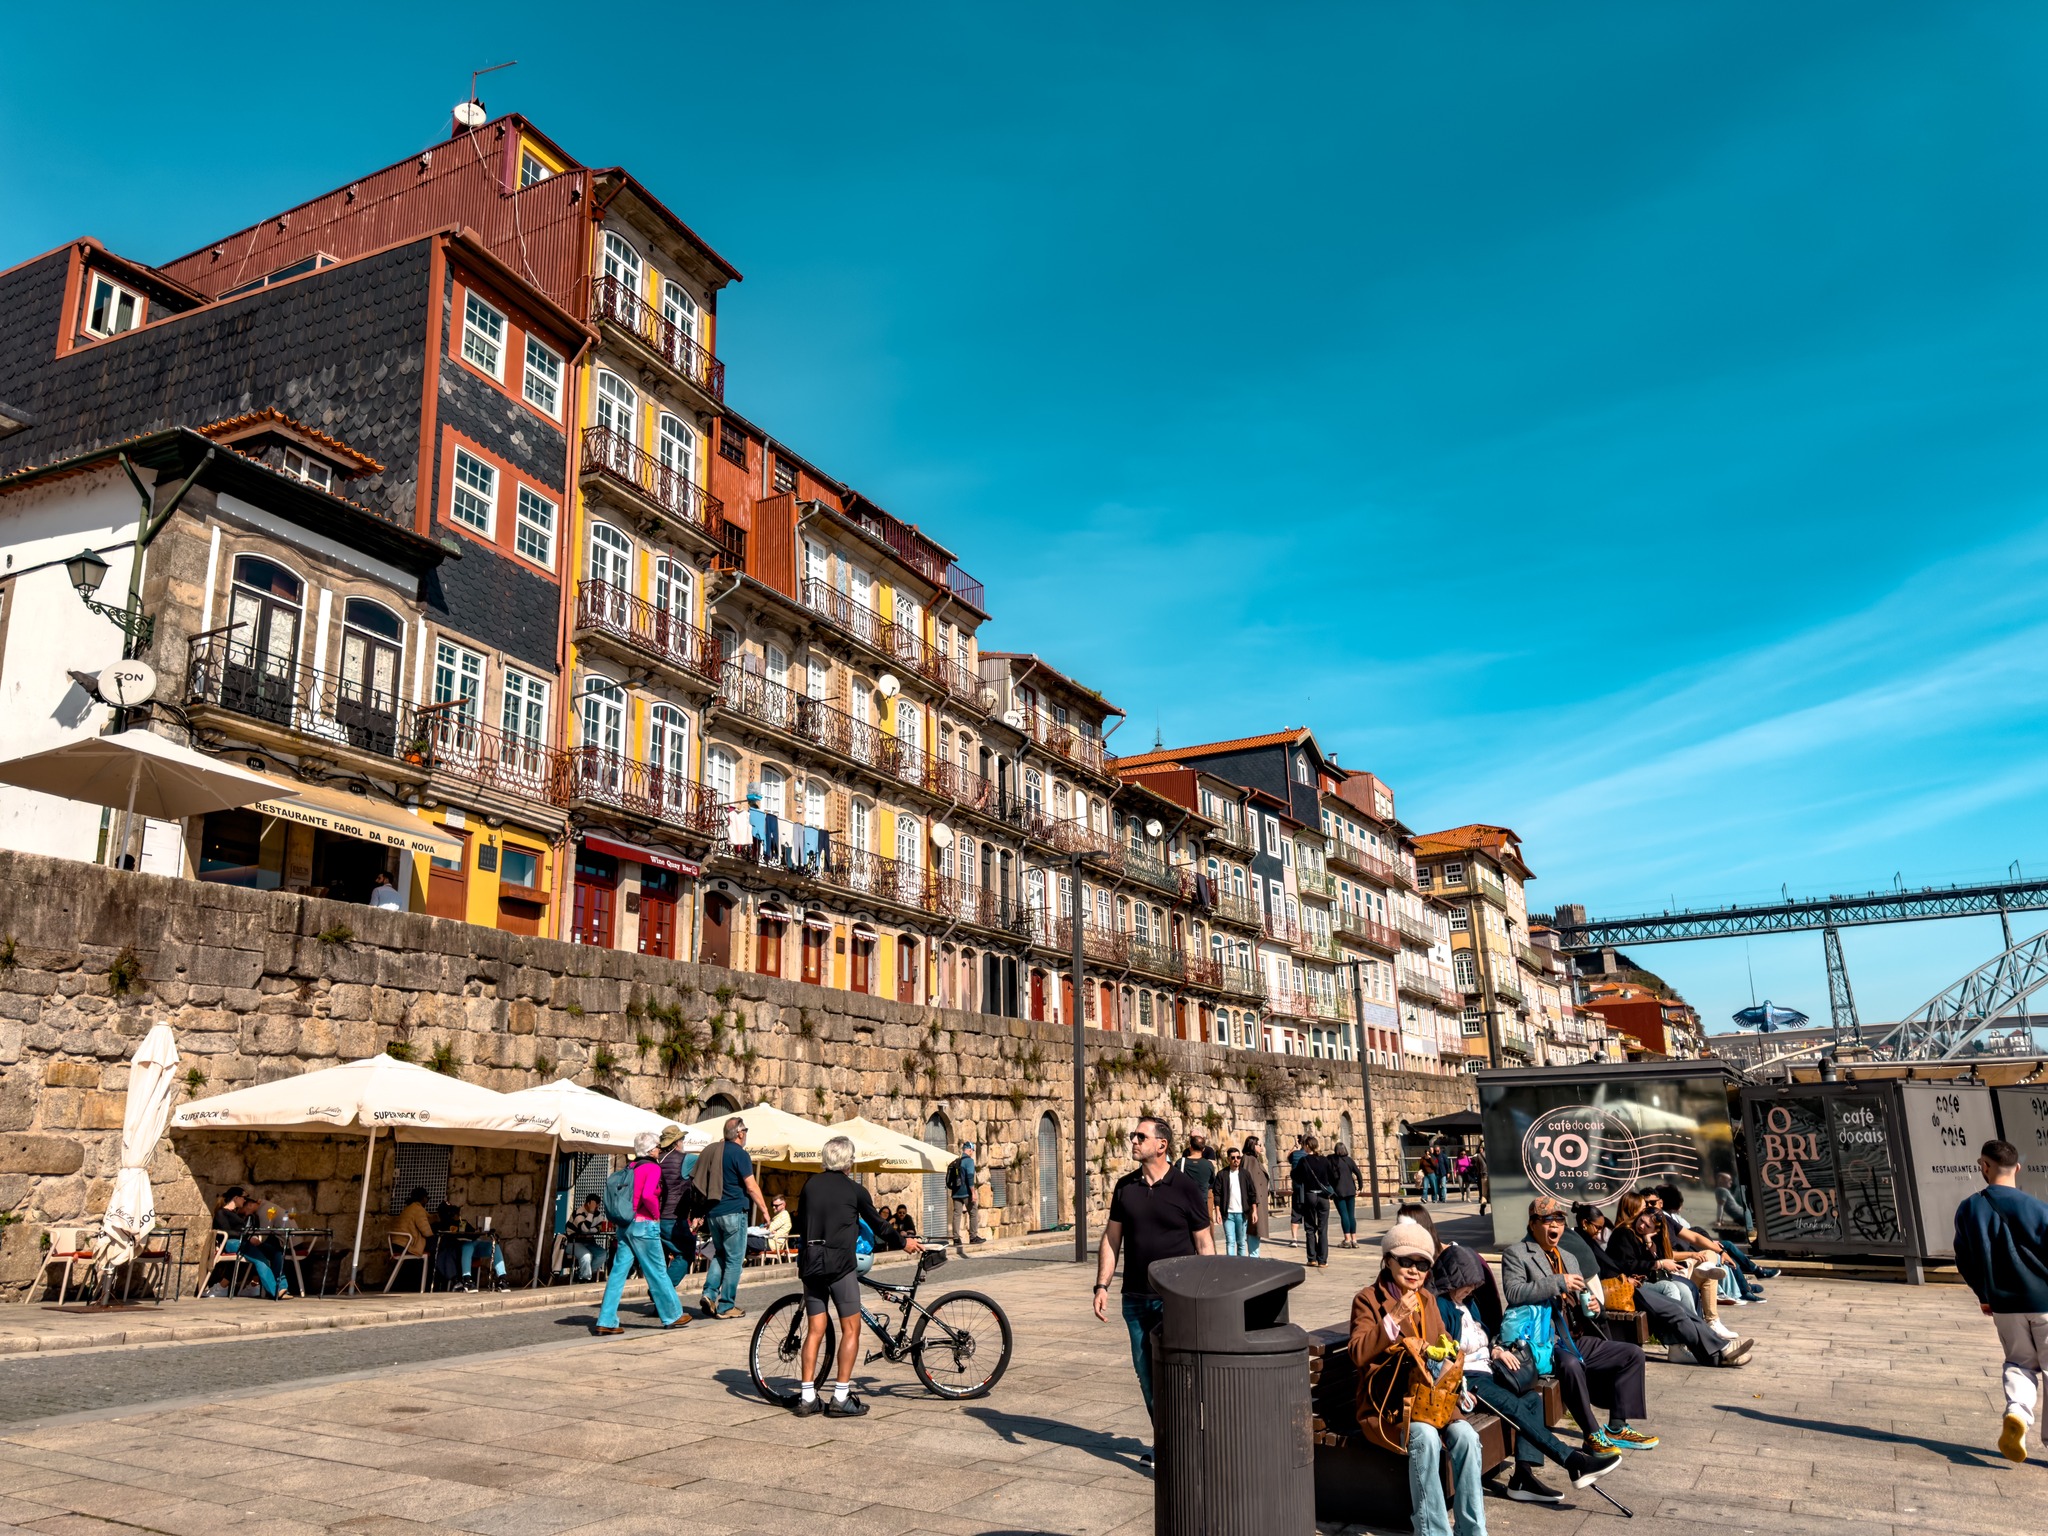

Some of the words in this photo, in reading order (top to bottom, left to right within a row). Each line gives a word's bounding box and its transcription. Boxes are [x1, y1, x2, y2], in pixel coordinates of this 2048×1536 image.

[114, 672, 144, 682] ZON
[255, 802, 328, 827] RESTAURANTE
[334, 822, 363, 837] FAROL
[369, 831, 381, 841] DA
[387, 836, 405, 847] BOA
[411, 841, 435, 854] NOVA
[650, 855, 665, 866] Wine
[666, 860, 680, 871] Quay
[682, 864, 692, 873] Bar
[179, 1112, 200, 1121] SUPER
[200, 1111, 219, 1119] BOCK
[1843, 1107, 1874, 1127] café
[586, 1130, 600, 1138] BOCK
[1763, 1133, 1820, 1161] BRI
[1534, 1133, 1589, 1180] 30
[1559, 1170, 1589, 1178] anos
[1761, 1161, 1812, 1188] GA
[1932, 1165, 1982, 1174] RESTAURANTE.BA
[1555, 1182, 1574, 1190] 199
[1588, 1182, 1607, 1190] 202
[1777, 1188, 1839, 1217] DO!
[1794, 1217, 1818, 1230] thank
